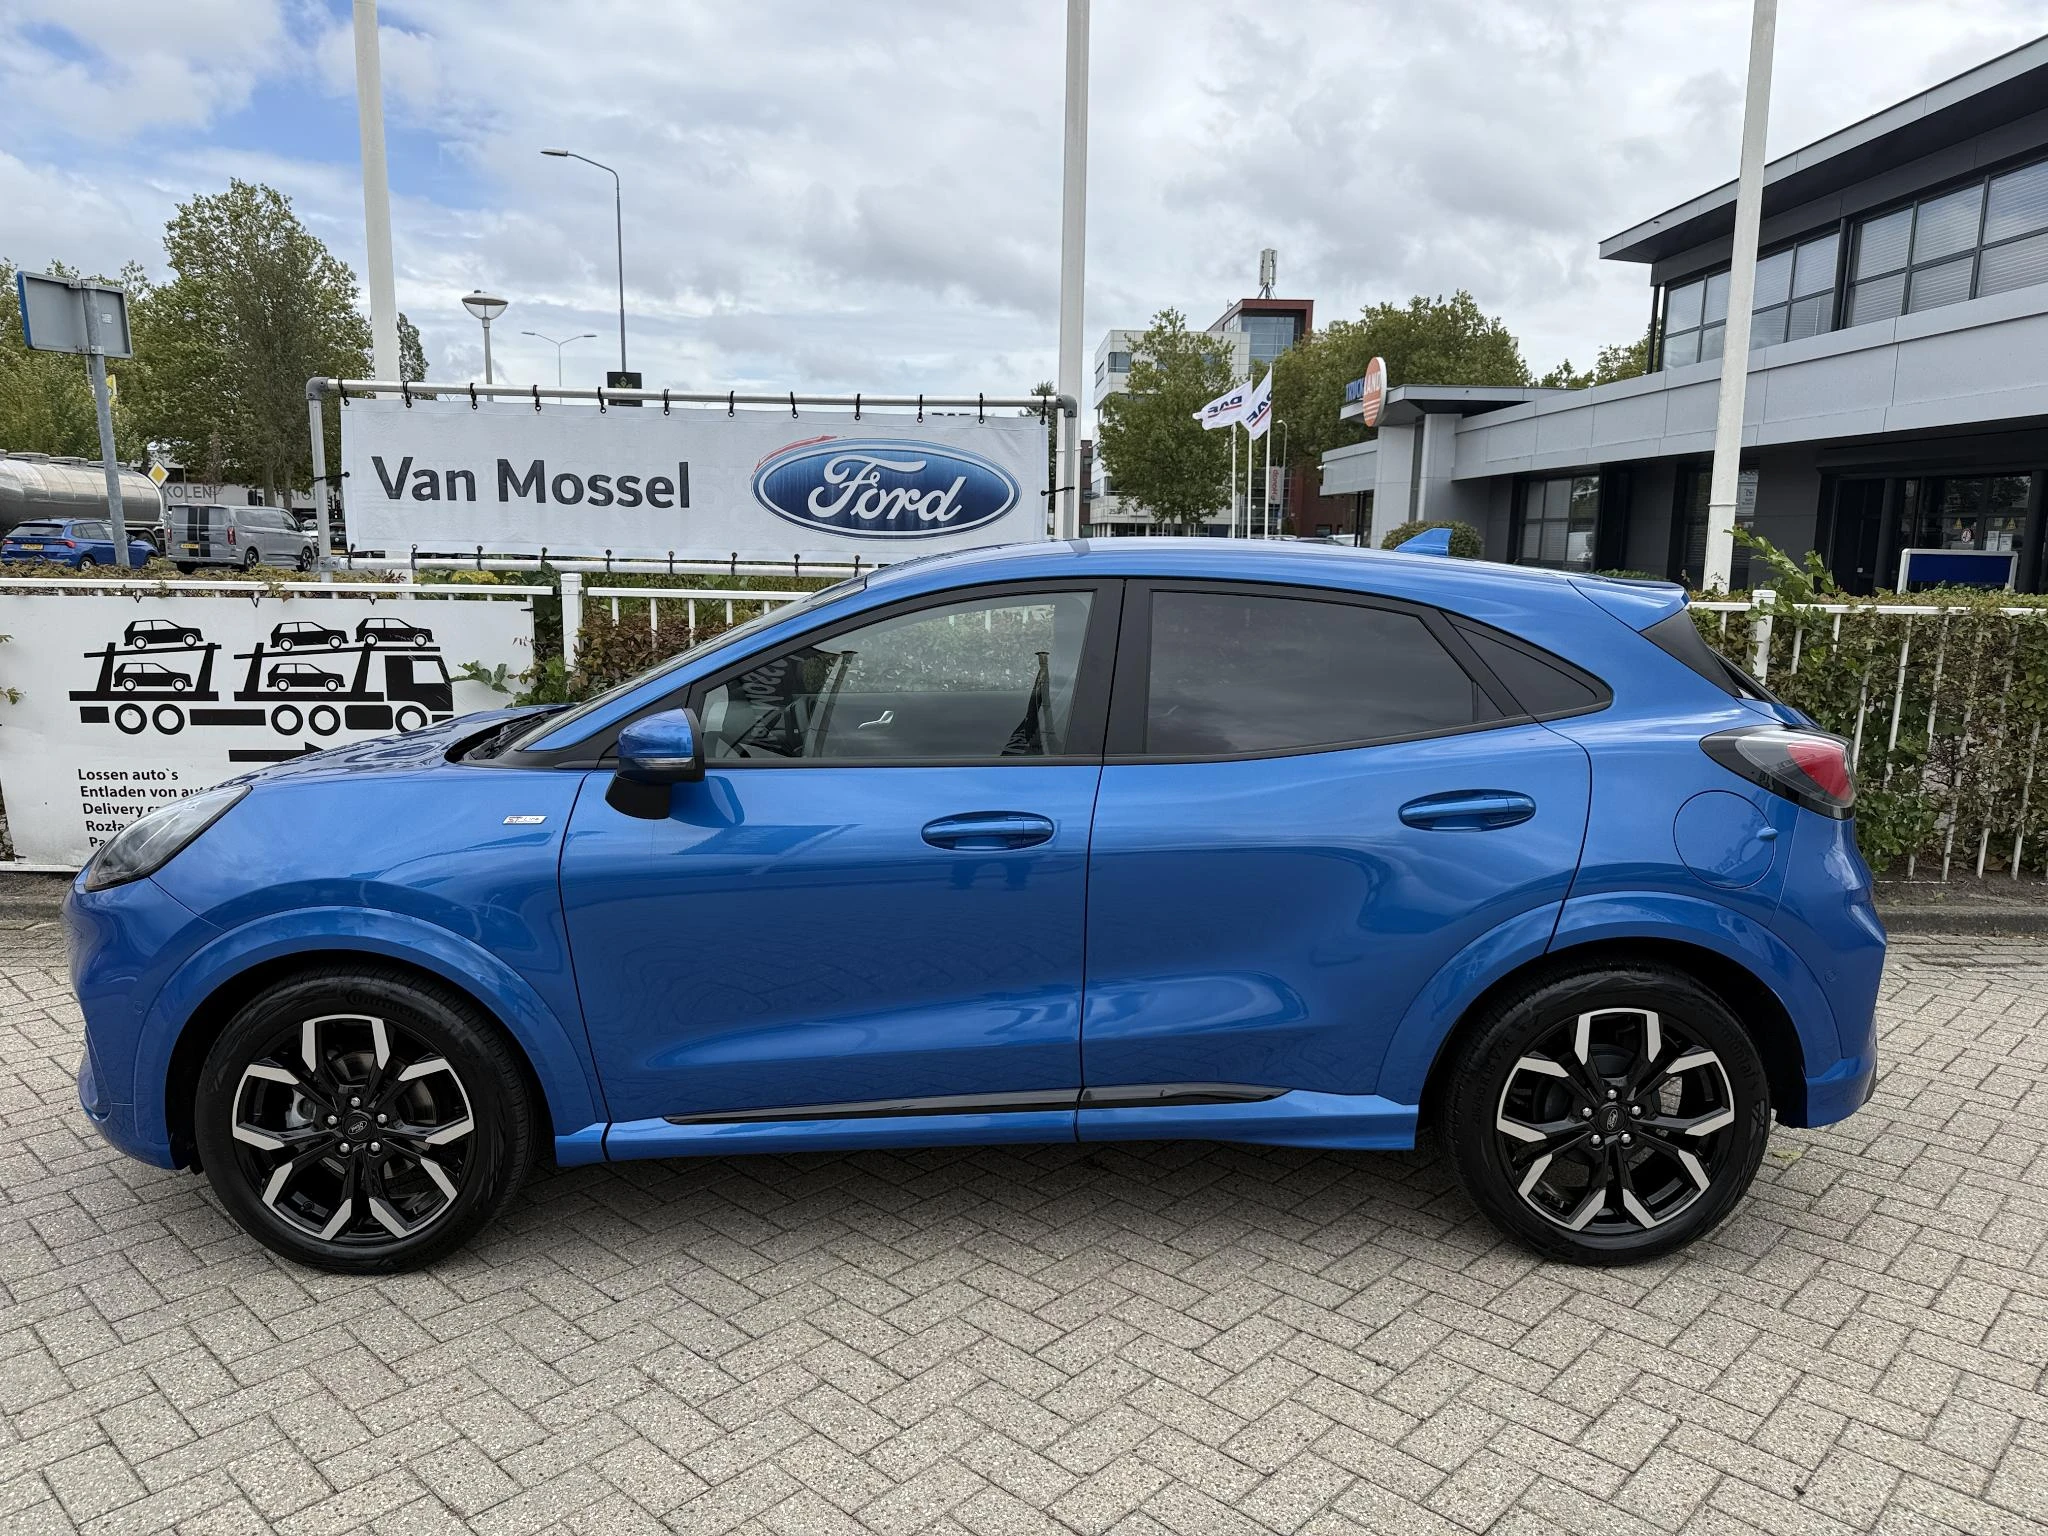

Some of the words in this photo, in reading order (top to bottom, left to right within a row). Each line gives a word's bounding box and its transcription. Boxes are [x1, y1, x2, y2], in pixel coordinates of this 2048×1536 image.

[371, 455, 477, 502] Van
[496, 458, 690, 509] Mossel
[806, 454, 968, 523] Ford
[78, 769, 129, 781] Lossen
[80, 785, 147, 798] Entladen
[149, 788, 177, 798] von
[83, 802, 144, 818] Delivery
[86, 820, 125, 832] Rozła
[89, 836, 106, 848] Pa
